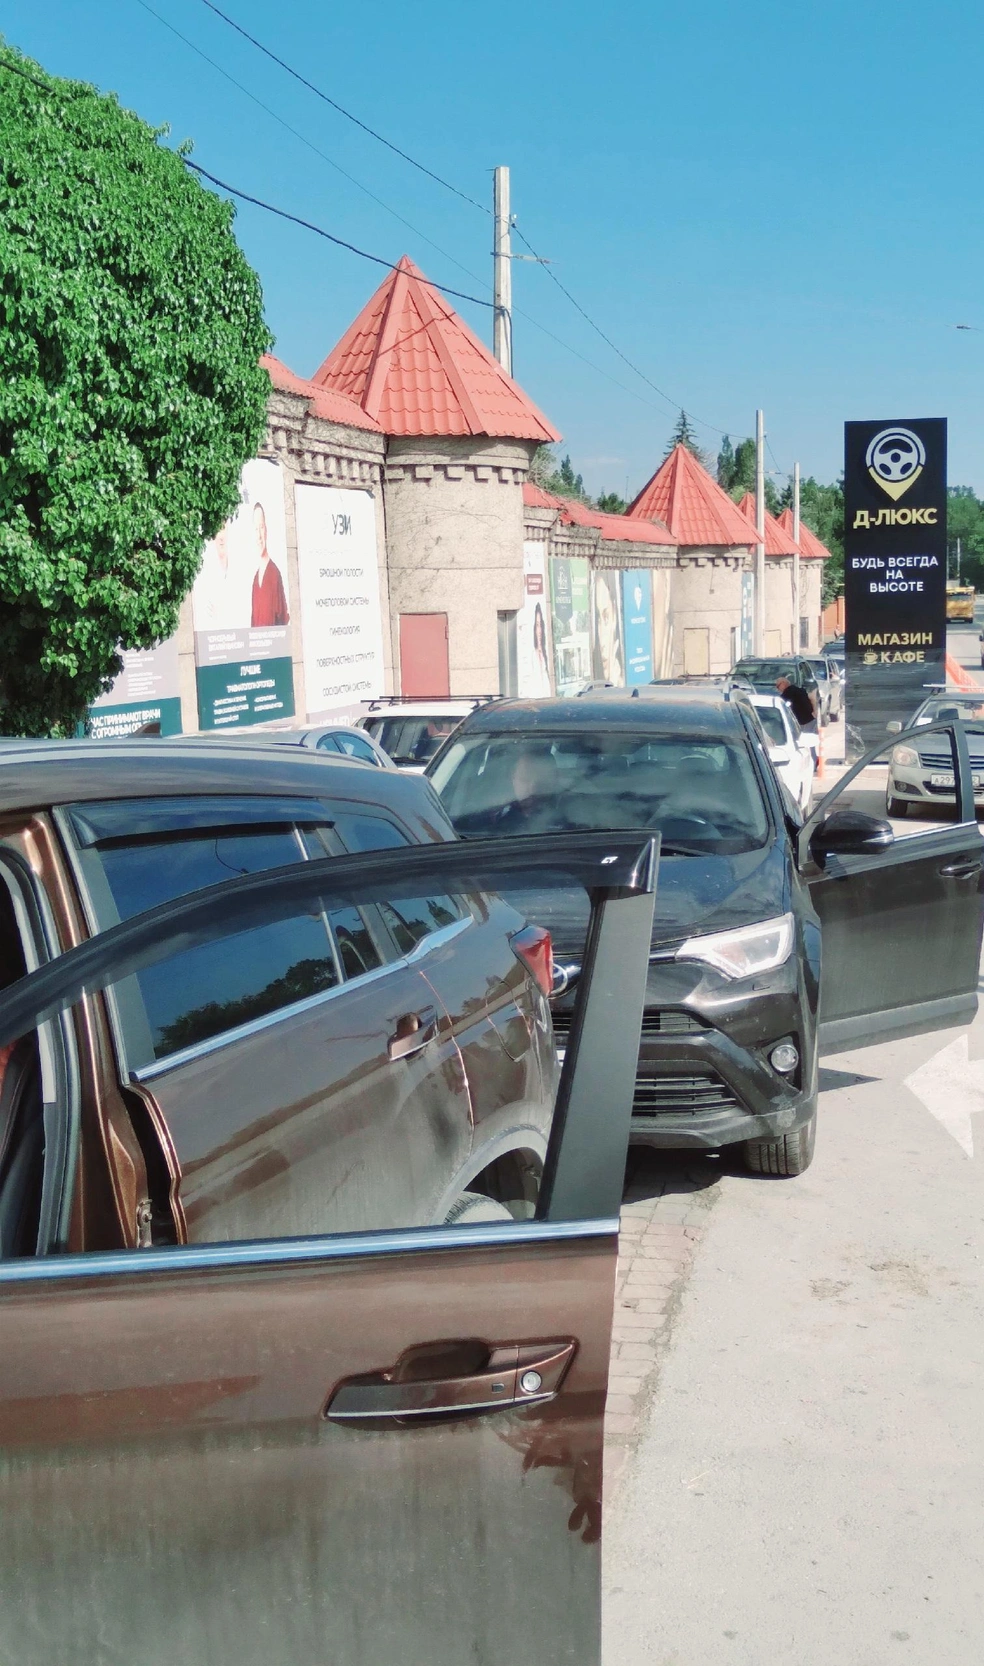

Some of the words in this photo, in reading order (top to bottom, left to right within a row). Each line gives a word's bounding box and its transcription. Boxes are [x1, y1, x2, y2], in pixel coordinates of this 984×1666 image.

[853, 508, 938, 529] Д-ЛЮКС
[331, 514, 352, 536] УЗИ
[852, 557, 885, 569] БУДЬ
[888, 556, 939, 568] ВСЕГДА
[886, 570, 904, 580] НА
[870, 582, 924, 593] ВЫСОТЕ
[858, 633, 933, 645] МАГАЗИН
[881, 651, 925, 663] КАФЕ
